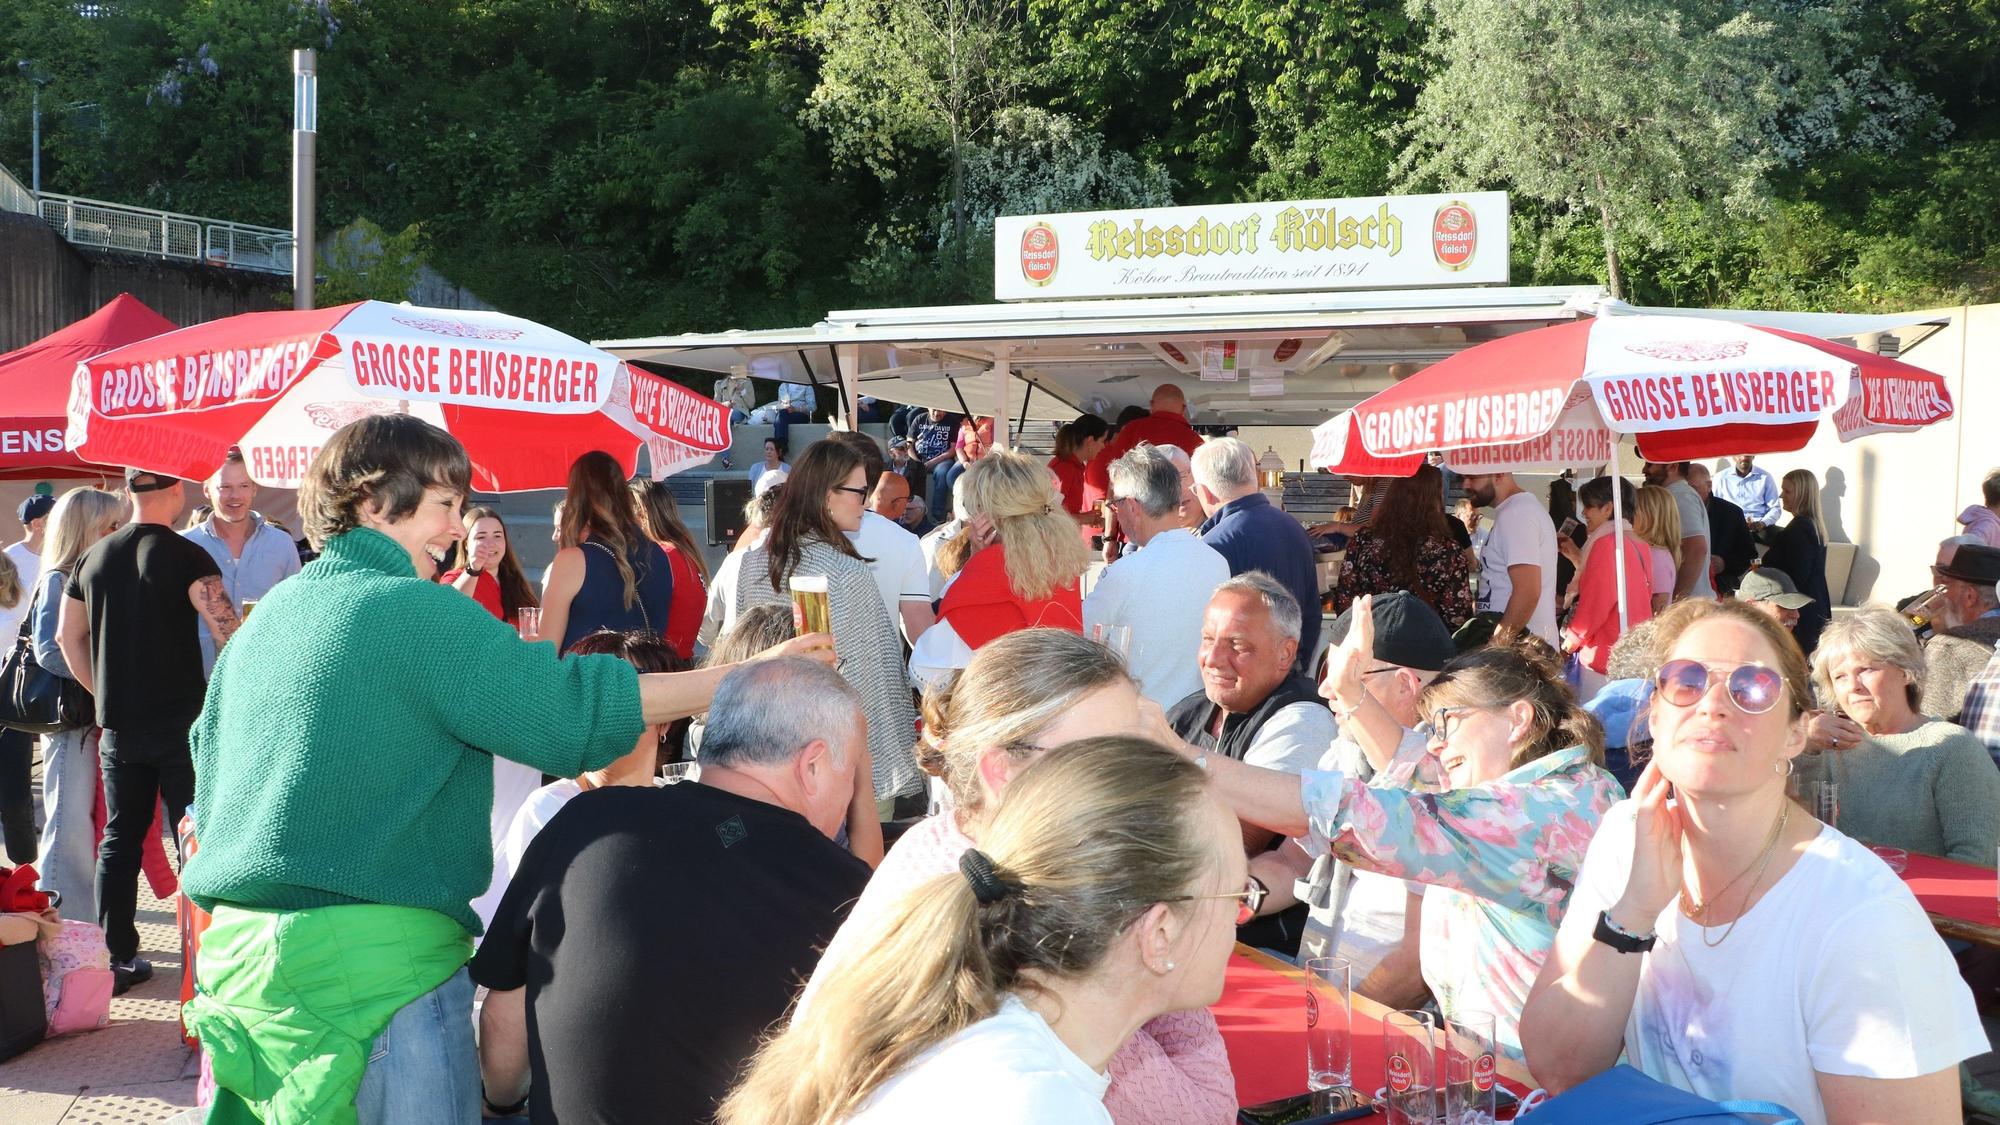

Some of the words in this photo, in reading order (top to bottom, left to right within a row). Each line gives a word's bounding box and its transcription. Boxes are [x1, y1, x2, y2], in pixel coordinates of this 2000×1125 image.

[1085, 212, 1262, 262] Reissdorf
[1270, 202, 1403, 257] Kölsch
[1113, 267, 1173, 285] Kölner
[1174, 264, 1288, 283] Brautradition
[1292, 264, 1323, 279] seit
[101, 357, 177, 413] GROSSE
[352, 340, 441, 393] GROSSE
[450, 348, 598, 403] BENSBERGER
[1603, 376, 1691, 422] GROSSE
[1692, 370, 1836, 418] BENSBERGER
[936, 431, 949, 440] 63
[1365, 404, 1438, 450] GROSSE
